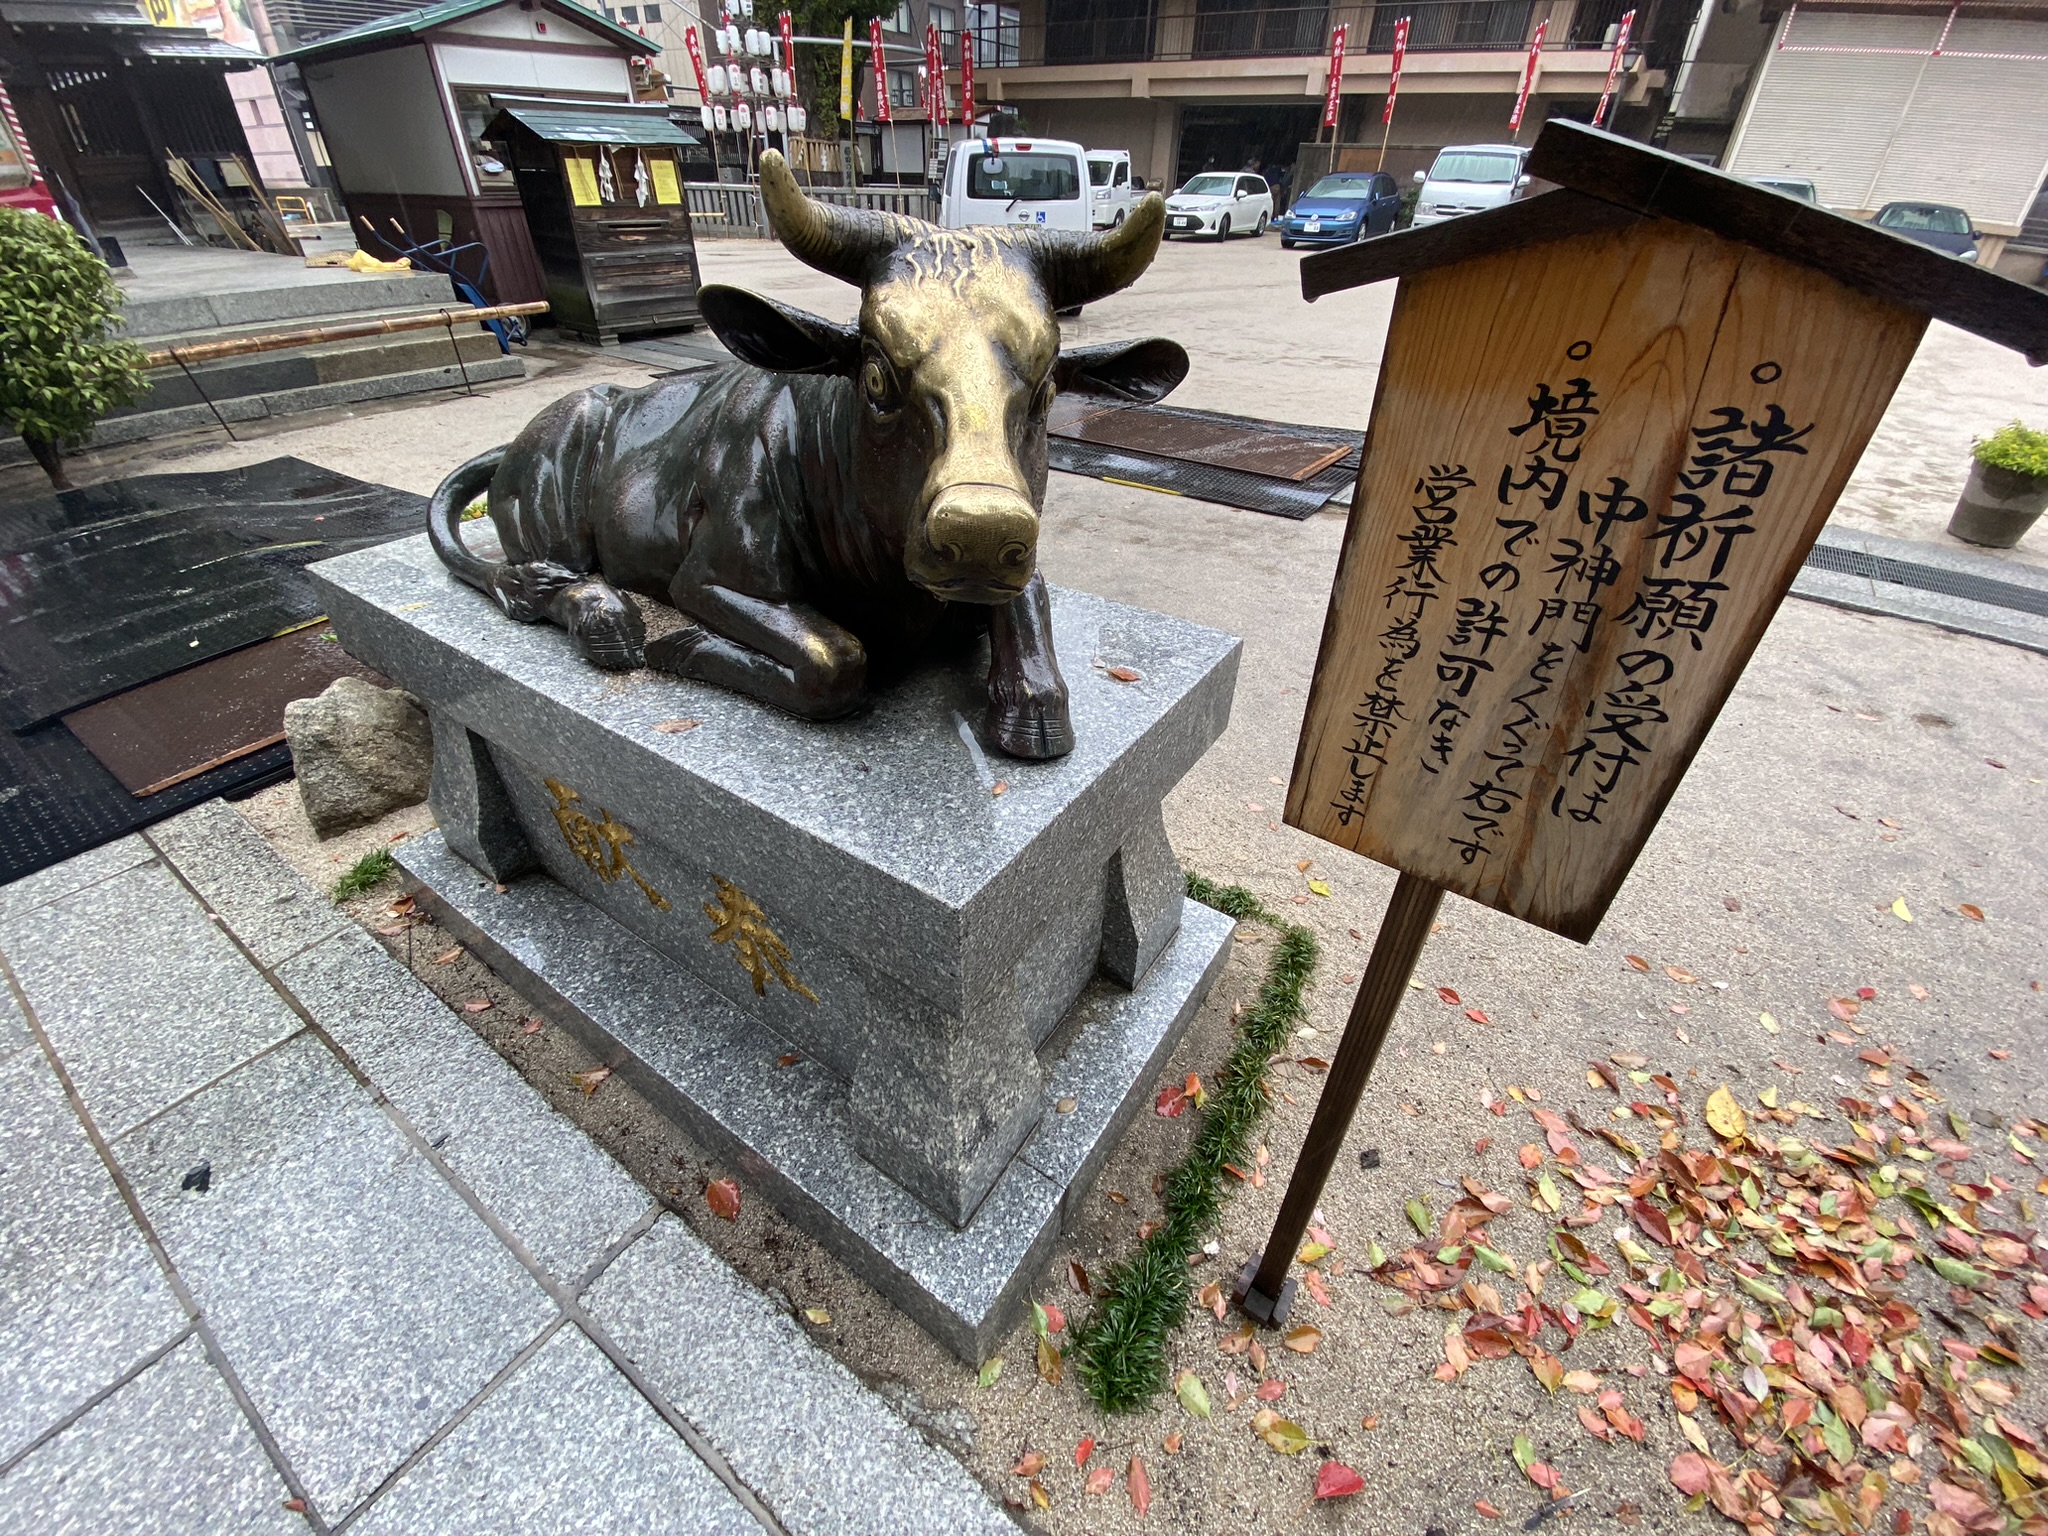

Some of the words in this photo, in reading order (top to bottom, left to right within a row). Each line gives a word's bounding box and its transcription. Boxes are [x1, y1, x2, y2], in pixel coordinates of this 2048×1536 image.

[1330, 463, 1477, 827] 営業行為を禁止します
[1420, 377, 1600, 775] 境内での許可なき
[1448, 476, 1649, 866] 中神門をくぐって右です
[1551, 404, 1816, 825] 諸祈願の受付は
